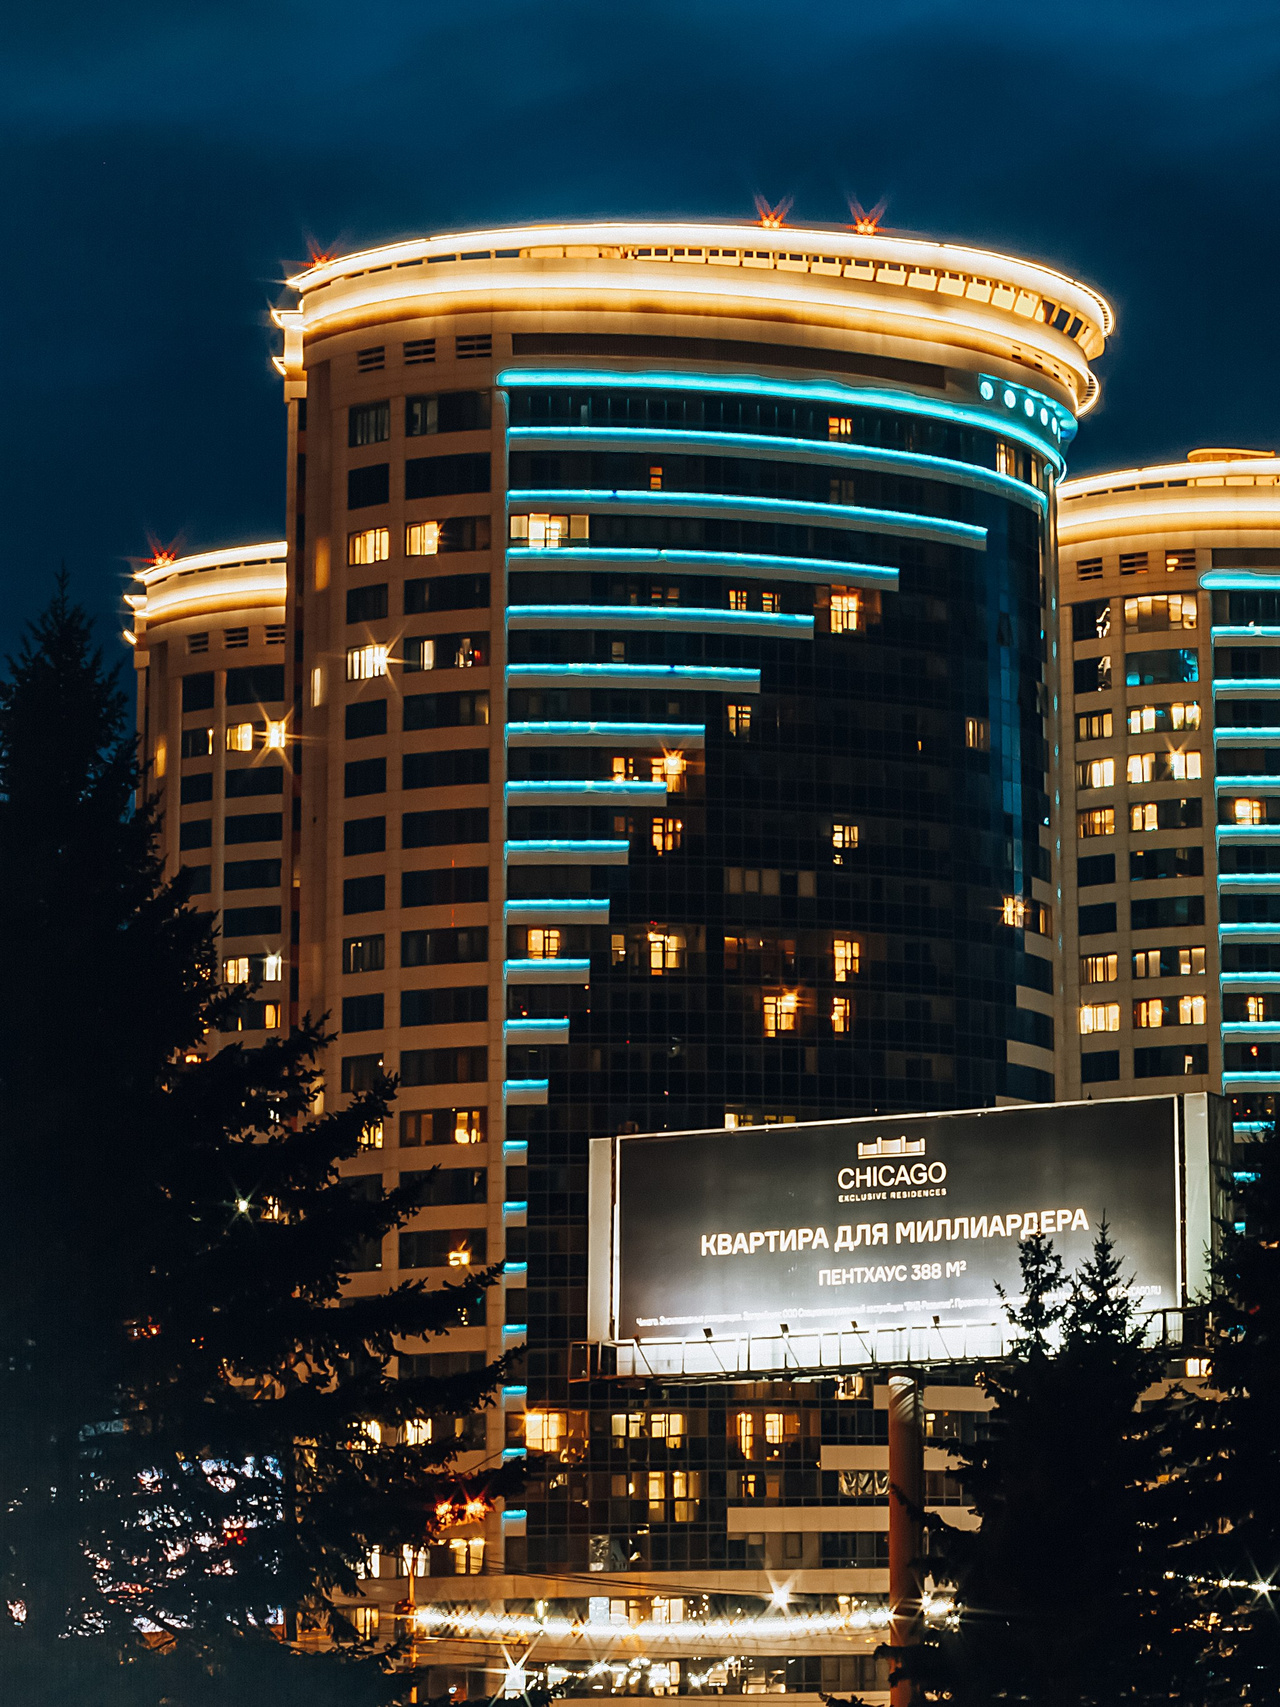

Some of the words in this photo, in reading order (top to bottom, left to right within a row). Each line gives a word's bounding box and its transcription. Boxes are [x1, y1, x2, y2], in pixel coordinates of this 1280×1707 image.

[837, 1161, 947, 1190] CHICAGO
[838, 1191, 887, 1203] EXCLUSIVE
[890, 1187, 947, 1199] RESIDENCES
[700, 1227, 830, 1257] КВАРТИРА
[834, 1222, 889, 1253] ДЛЯ
[895, 1208, 1090, 1244] МИЛЛИАРДЕРА
[818, 1264, 908, 1287] ПЕНТХАУС
[911, 1262, 942, 1281] 388
